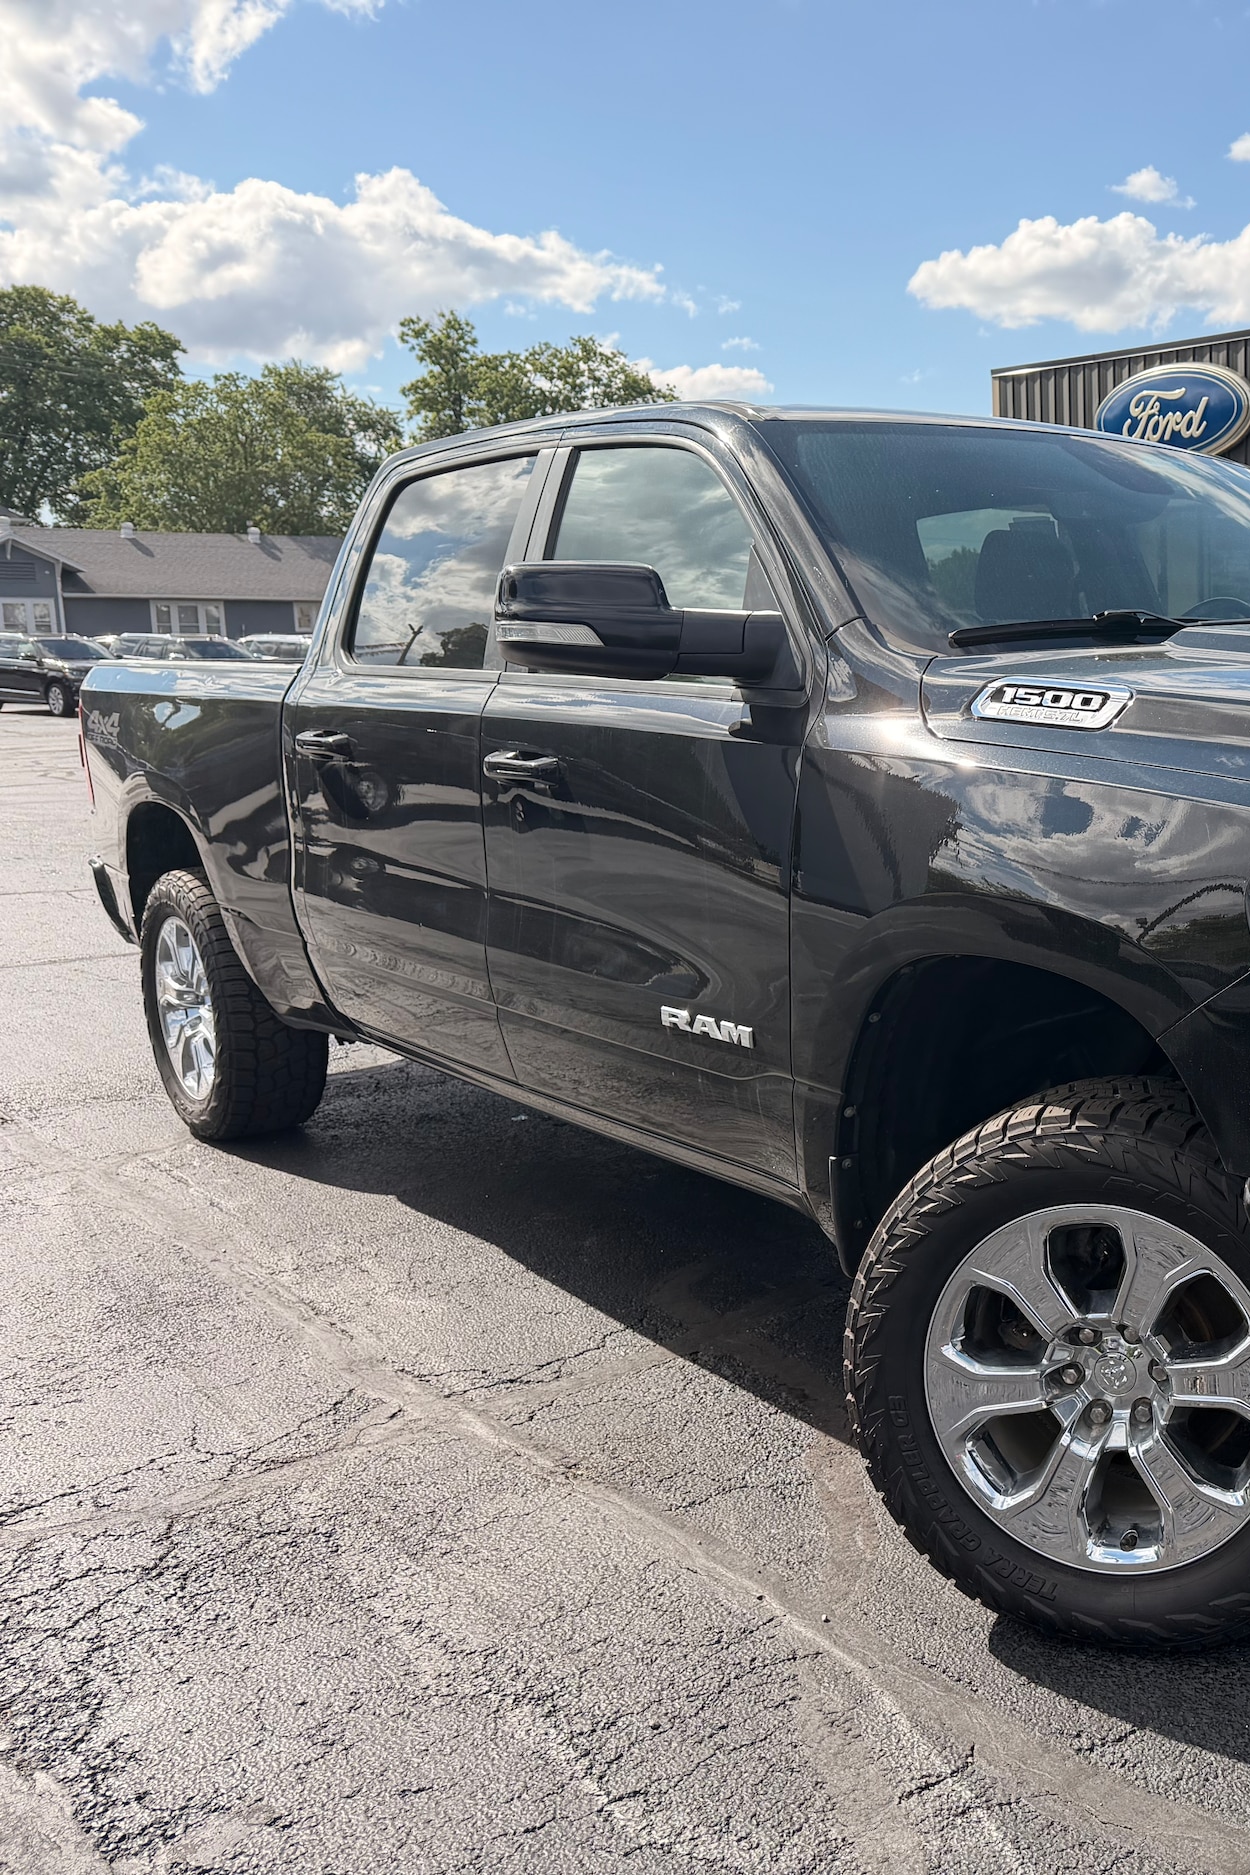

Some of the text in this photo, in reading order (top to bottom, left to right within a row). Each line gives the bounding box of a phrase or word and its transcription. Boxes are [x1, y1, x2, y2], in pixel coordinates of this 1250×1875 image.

[1122, 387, 1210, 442] Ford
[1002, 687, 1103, 710] 1500
[660, 1005, 754, 1049] RAM
[899, 1434, 981, 1552] GRAPPLER
[982, 1548, 1057, 1600] TERRA
